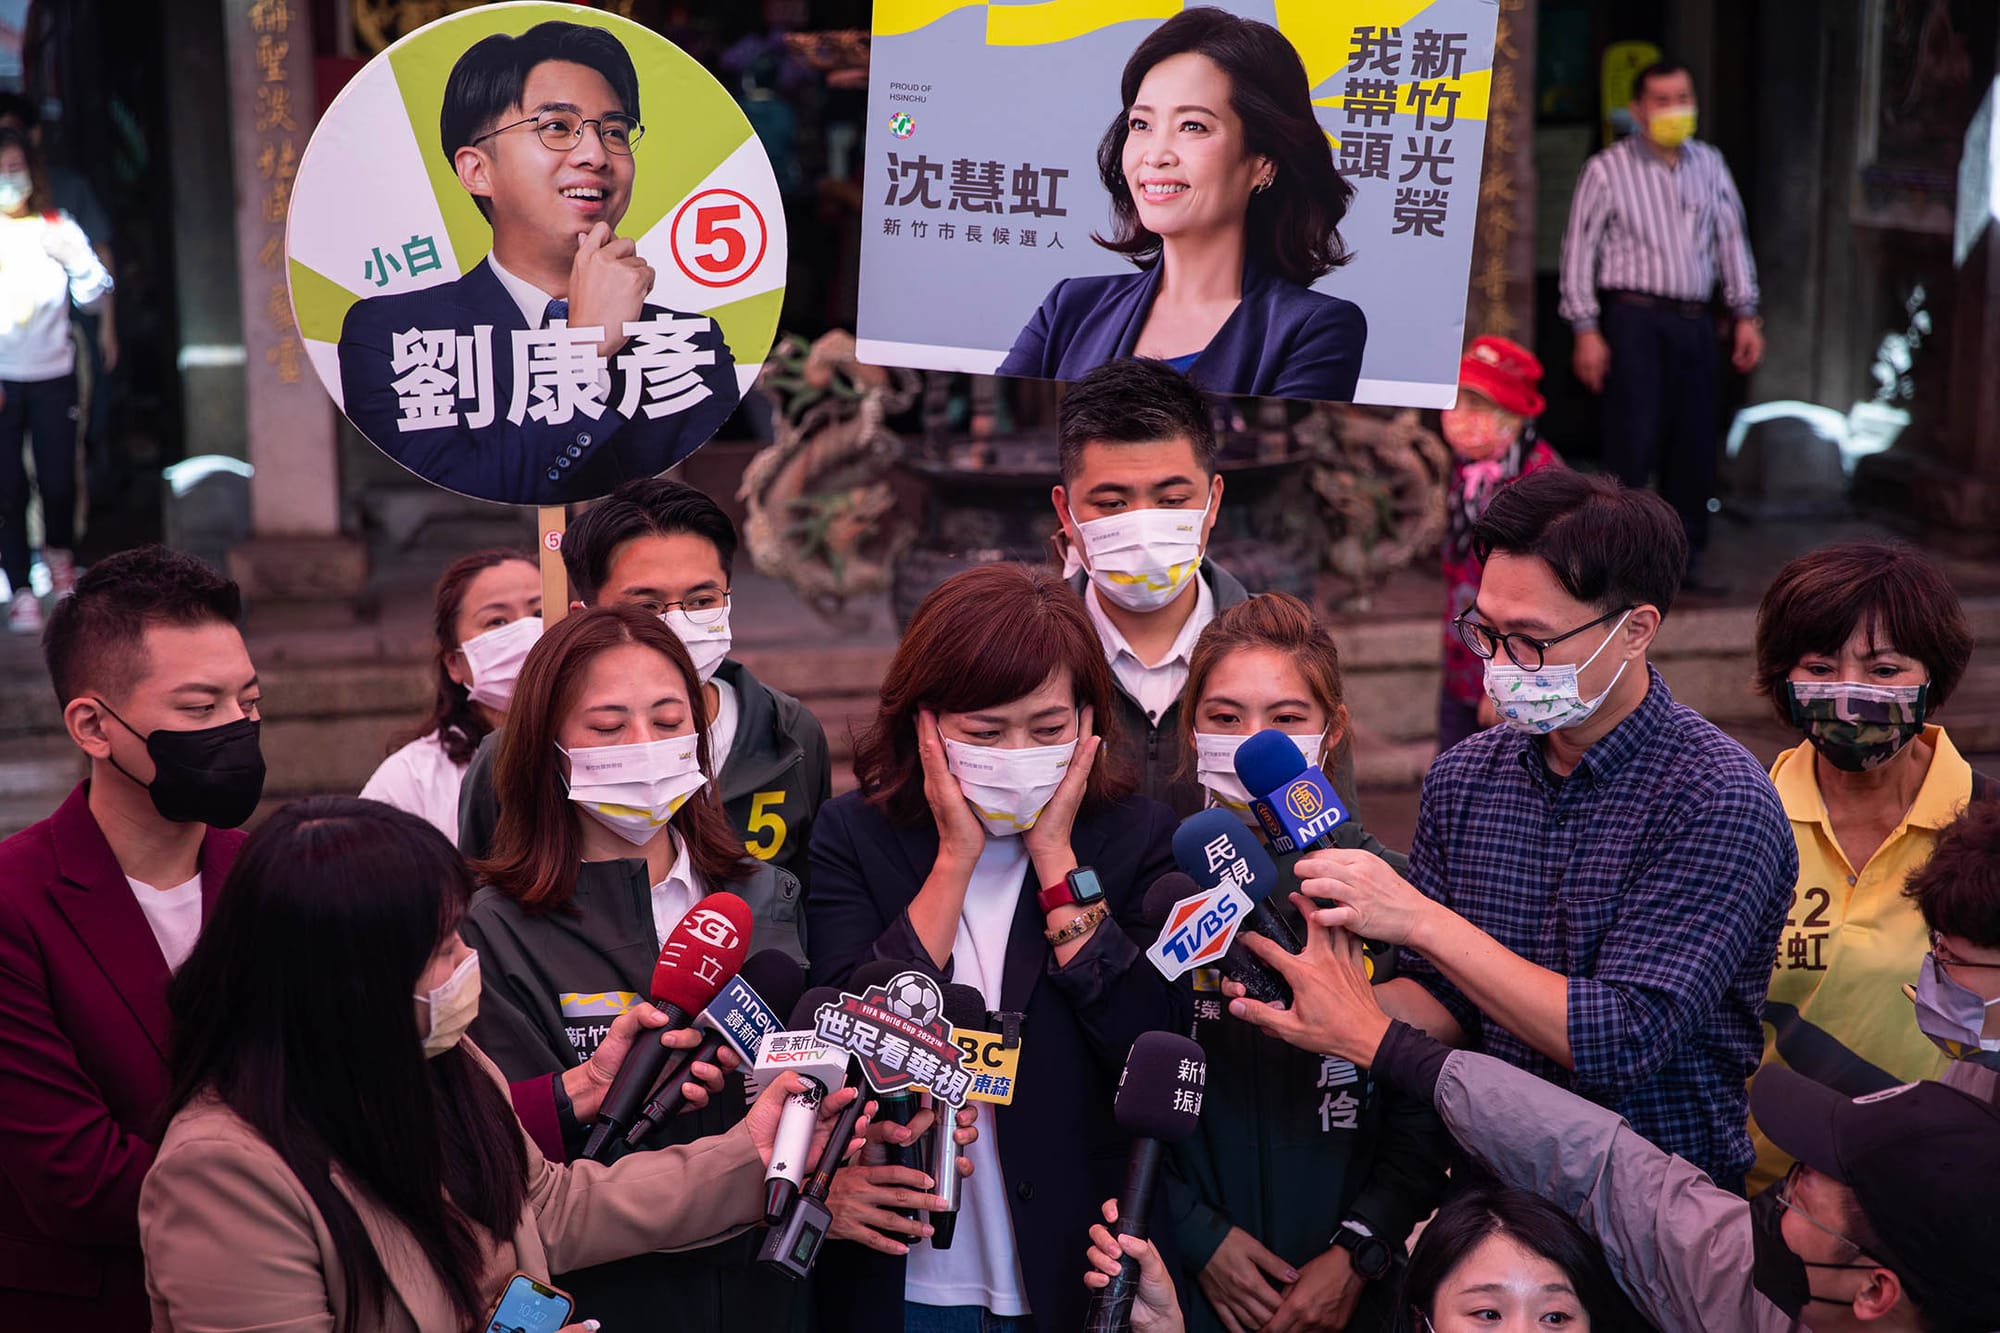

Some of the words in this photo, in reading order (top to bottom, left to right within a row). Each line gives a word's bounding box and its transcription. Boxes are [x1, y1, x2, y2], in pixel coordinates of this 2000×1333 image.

[889, 93, 927, 103] HSINCHU
[890, 82, 919, 91] PROUD
[920, 84, 932, 92] OF
[1337, 25, 1402, 180] 我帶頭
[1391, 28, 1468, 238] 新竹光榮
[884, 151, 1069, 218] 沈慧虹
[363, 234, 443, 288] 小白
[694, 203, 747, 274] 5
[883, 217, 1065, 250] 新竹市長候選人
[744, 790, 787, 861] 5
[1298, 807, 1341, 844] NTD
[1162, 893, 1239, 964] TVBS
[862, 1005, 877, 1017] FIFA
[879, 1012, 901, 1027] World
[902, 1022, 916, 1034] Cup
[1194, 1000, 1221, 1020] 榮
[819, 1008, 969, 1102] 世足看華視
